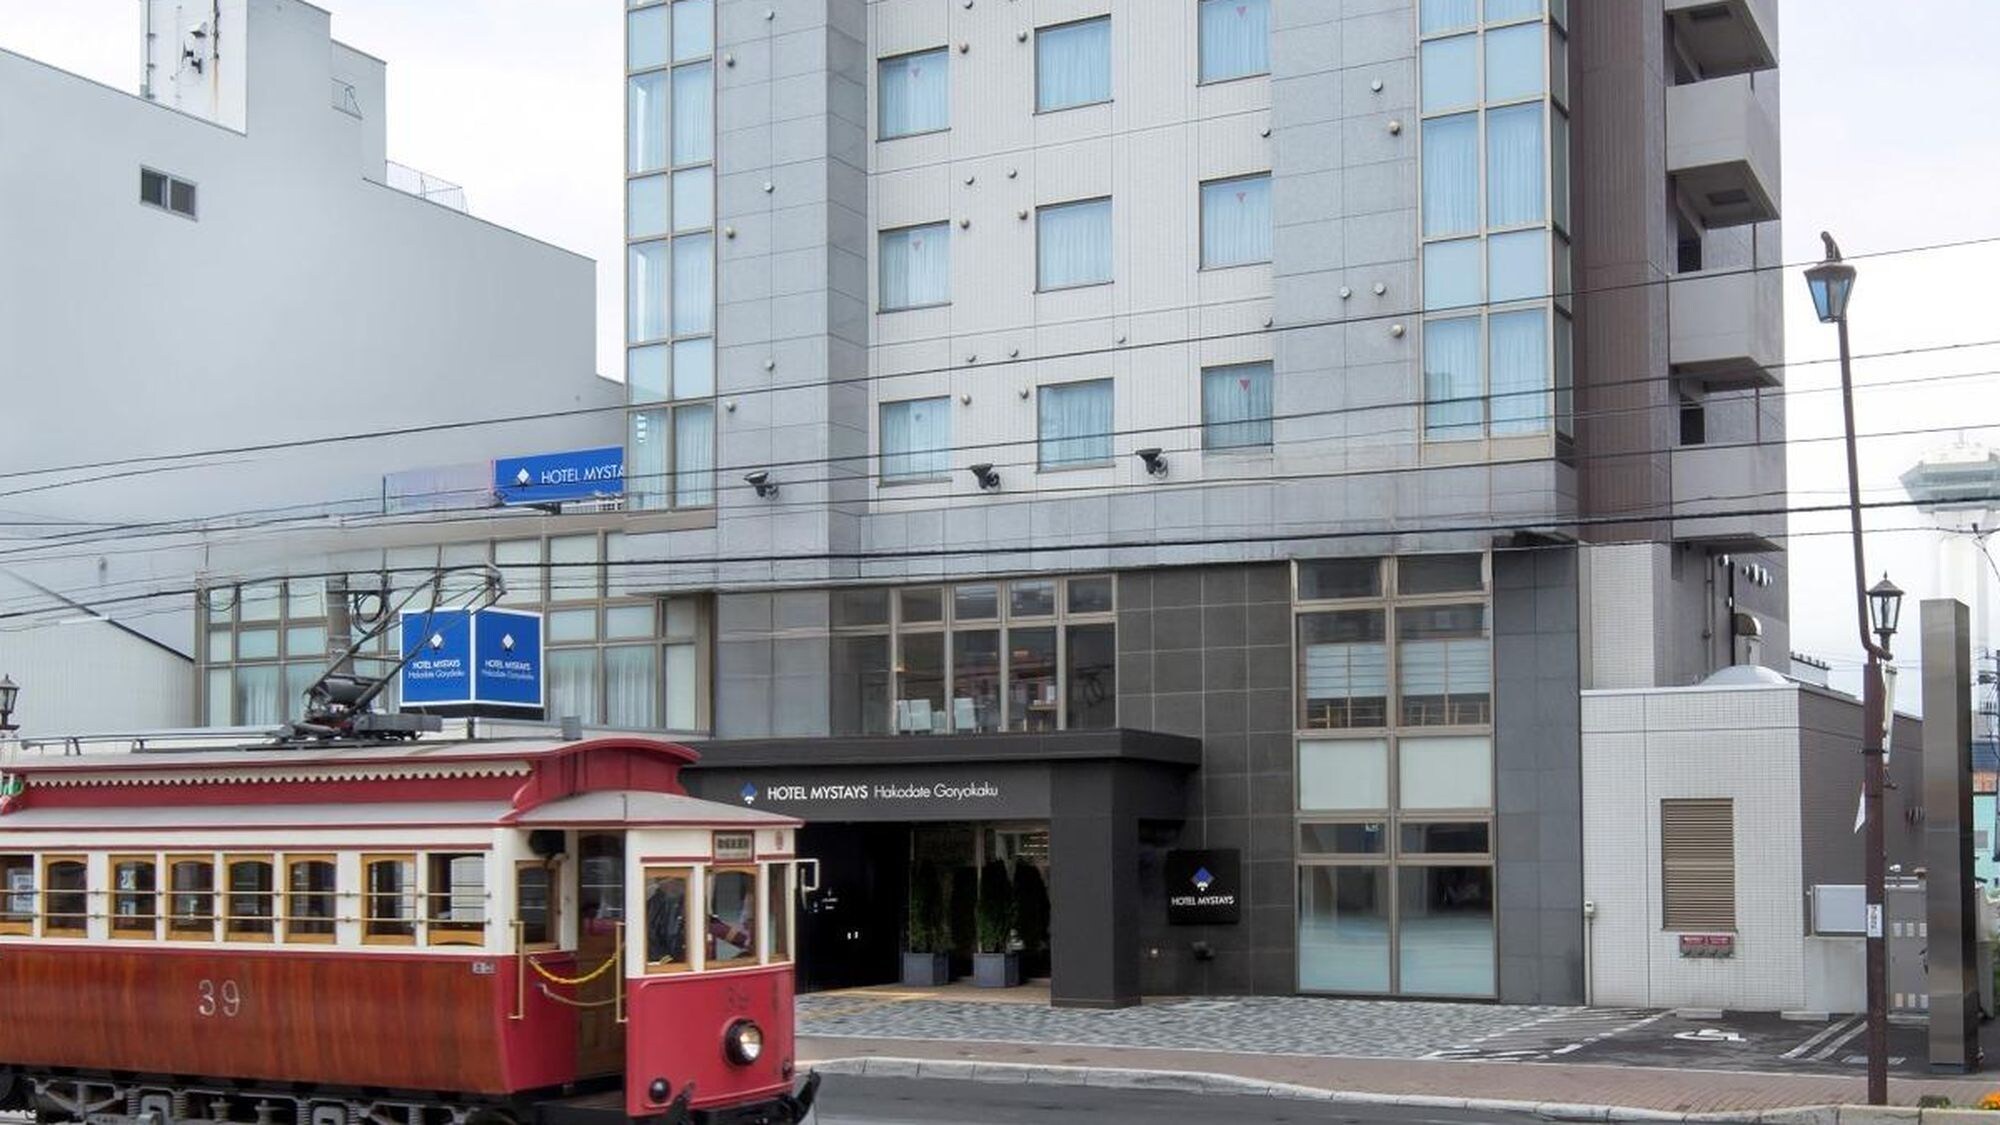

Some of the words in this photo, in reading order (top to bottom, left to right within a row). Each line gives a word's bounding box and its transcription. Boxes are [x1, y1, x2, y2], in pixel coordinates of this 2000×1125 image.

[541, 468, 579, 484] HOTEL
[767, 786, 807, 800] HOTEL
[810, 784, 868, 799] MYSTAYS
[874, 783, 931, 798] Hakodate
[933, 781, 998, 800] Goryokaku
[1171, 896, 1196, 906] HOTEL
[1197, 895, 1234, 906] MYSTAYS
[198, 979, 240, 1016] 39
